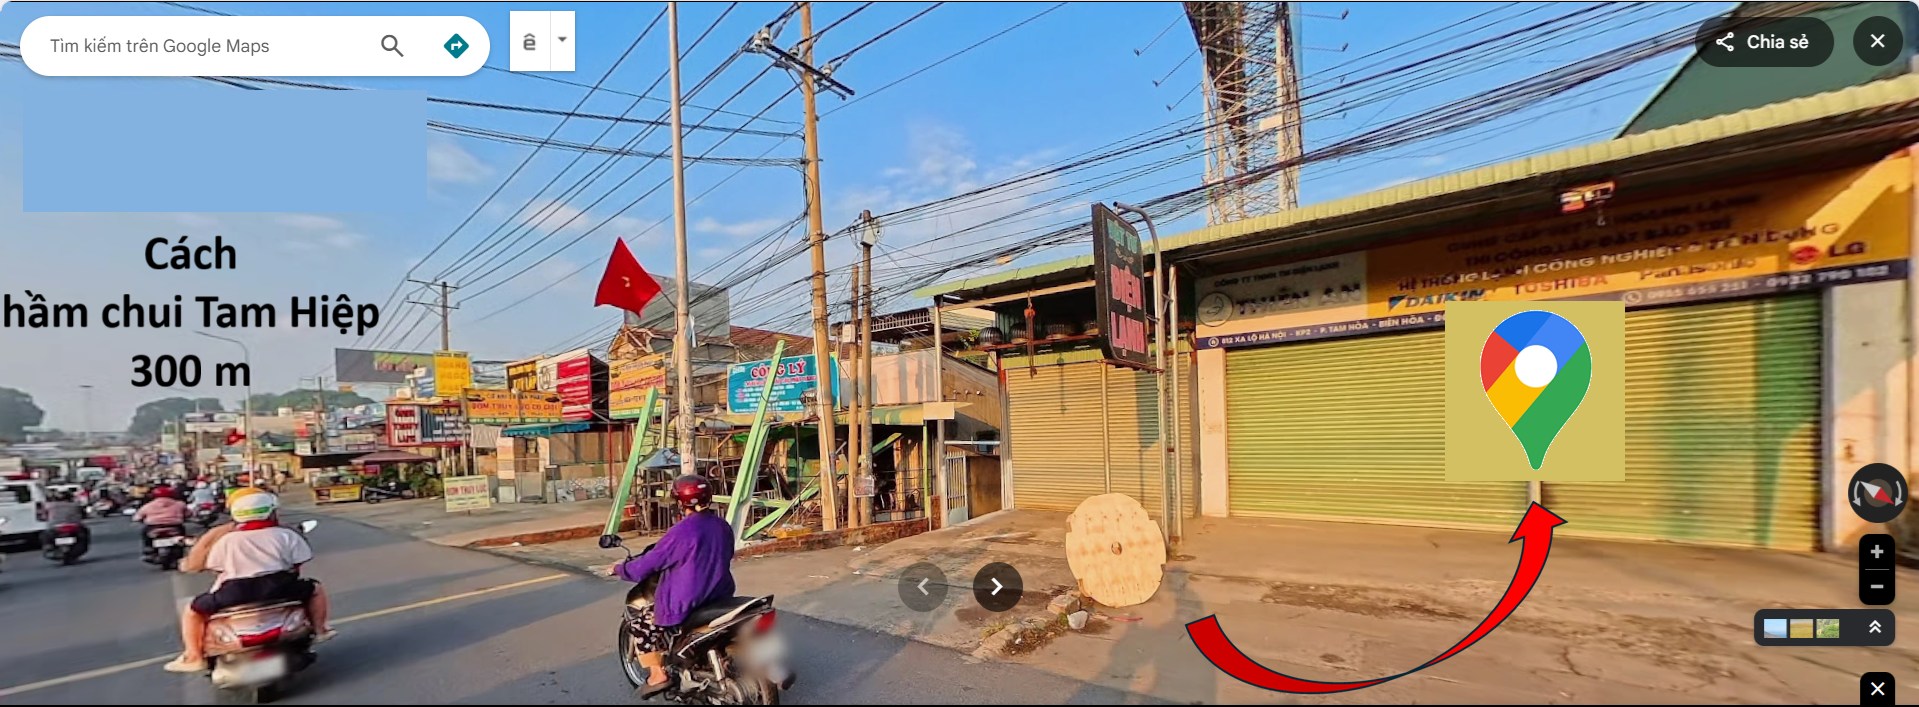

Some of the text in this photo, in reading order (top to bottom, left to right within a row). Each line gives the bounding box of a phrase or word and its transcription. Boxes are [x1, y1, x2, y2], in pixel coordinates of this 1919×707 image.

[1828, 242, 1866, 258] LG
[1533, 256, 1595, 274] CÔNG
[1514, 273, 1608, 295] TOSHIBA
[1405, 287, 1486, 308] DAIKIN
[1329, 324, 1346, 333] TAM
[788, 358, 807, 375] LÝ
